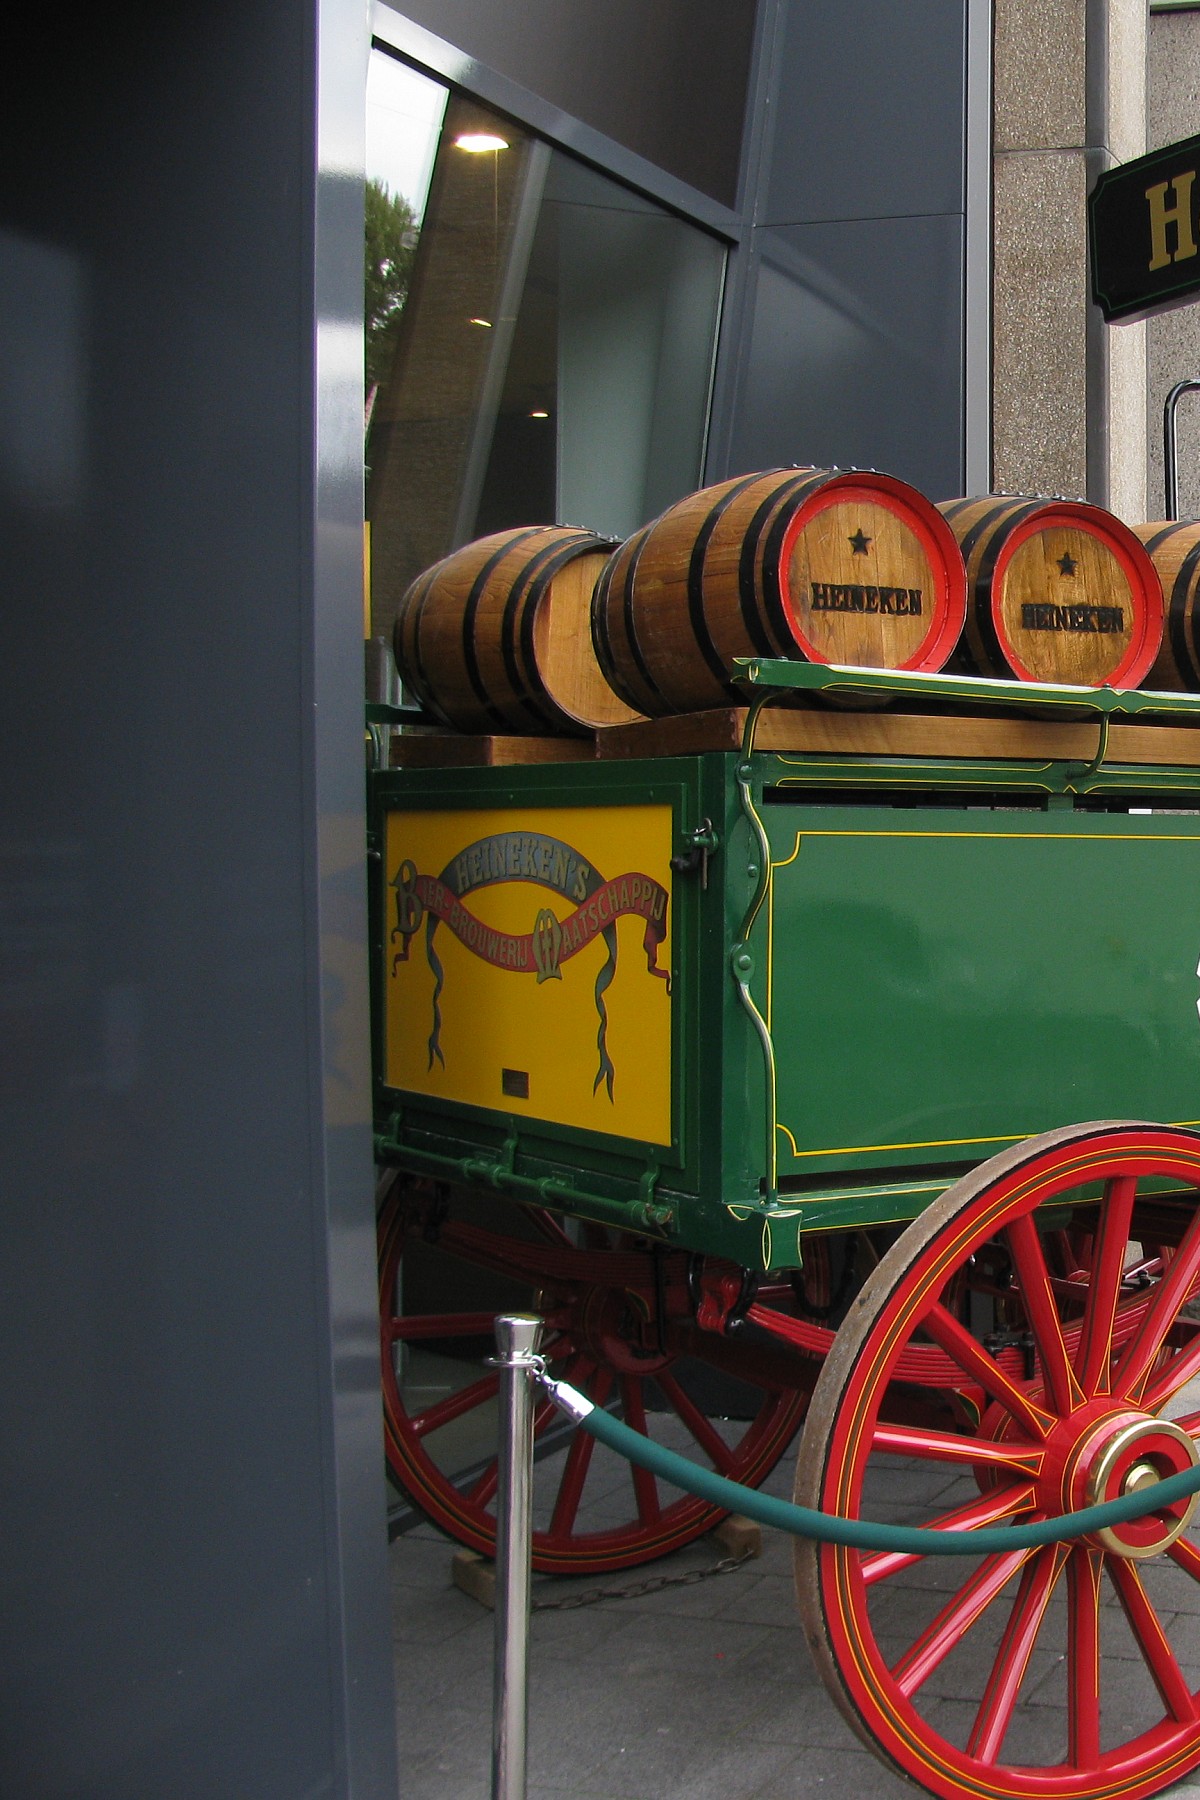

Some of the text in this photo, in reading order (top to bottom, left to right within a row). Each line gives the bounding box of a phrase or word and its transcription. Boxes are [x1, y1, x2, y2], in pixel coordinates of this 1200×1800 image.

[811, 582, 922, 616] HEINEKEN
[1021, 603, 1125, 634] HEINEKEN
[456, 838, 590, 901] HEINEKEN'S
